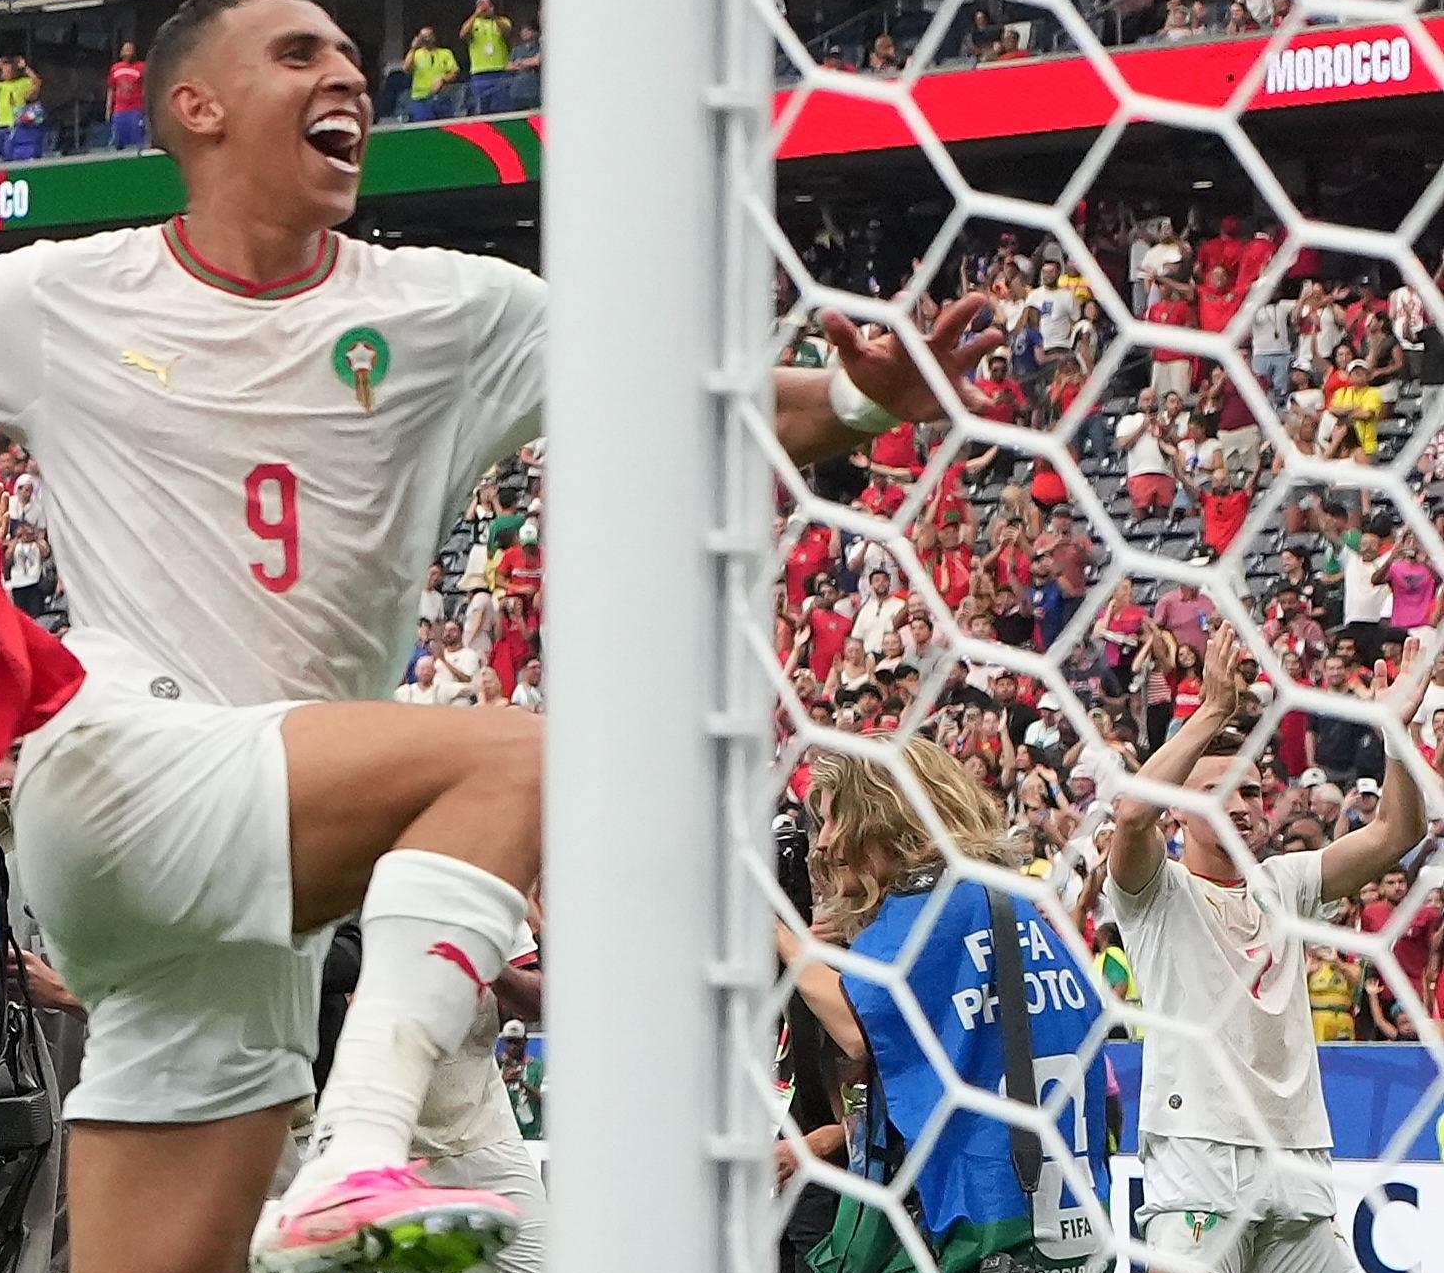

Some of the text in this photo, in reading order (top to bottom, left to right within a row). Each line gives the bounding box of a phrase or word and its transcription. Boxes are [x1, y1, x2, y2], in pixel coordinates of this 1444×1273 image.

[1266, 37, 1411, 94] MOROCCO
[243, 462, 301, 594] 9
[964, 919, 1055, 973] FFA
[1059, 1216, 1093, 1242] FIFA
